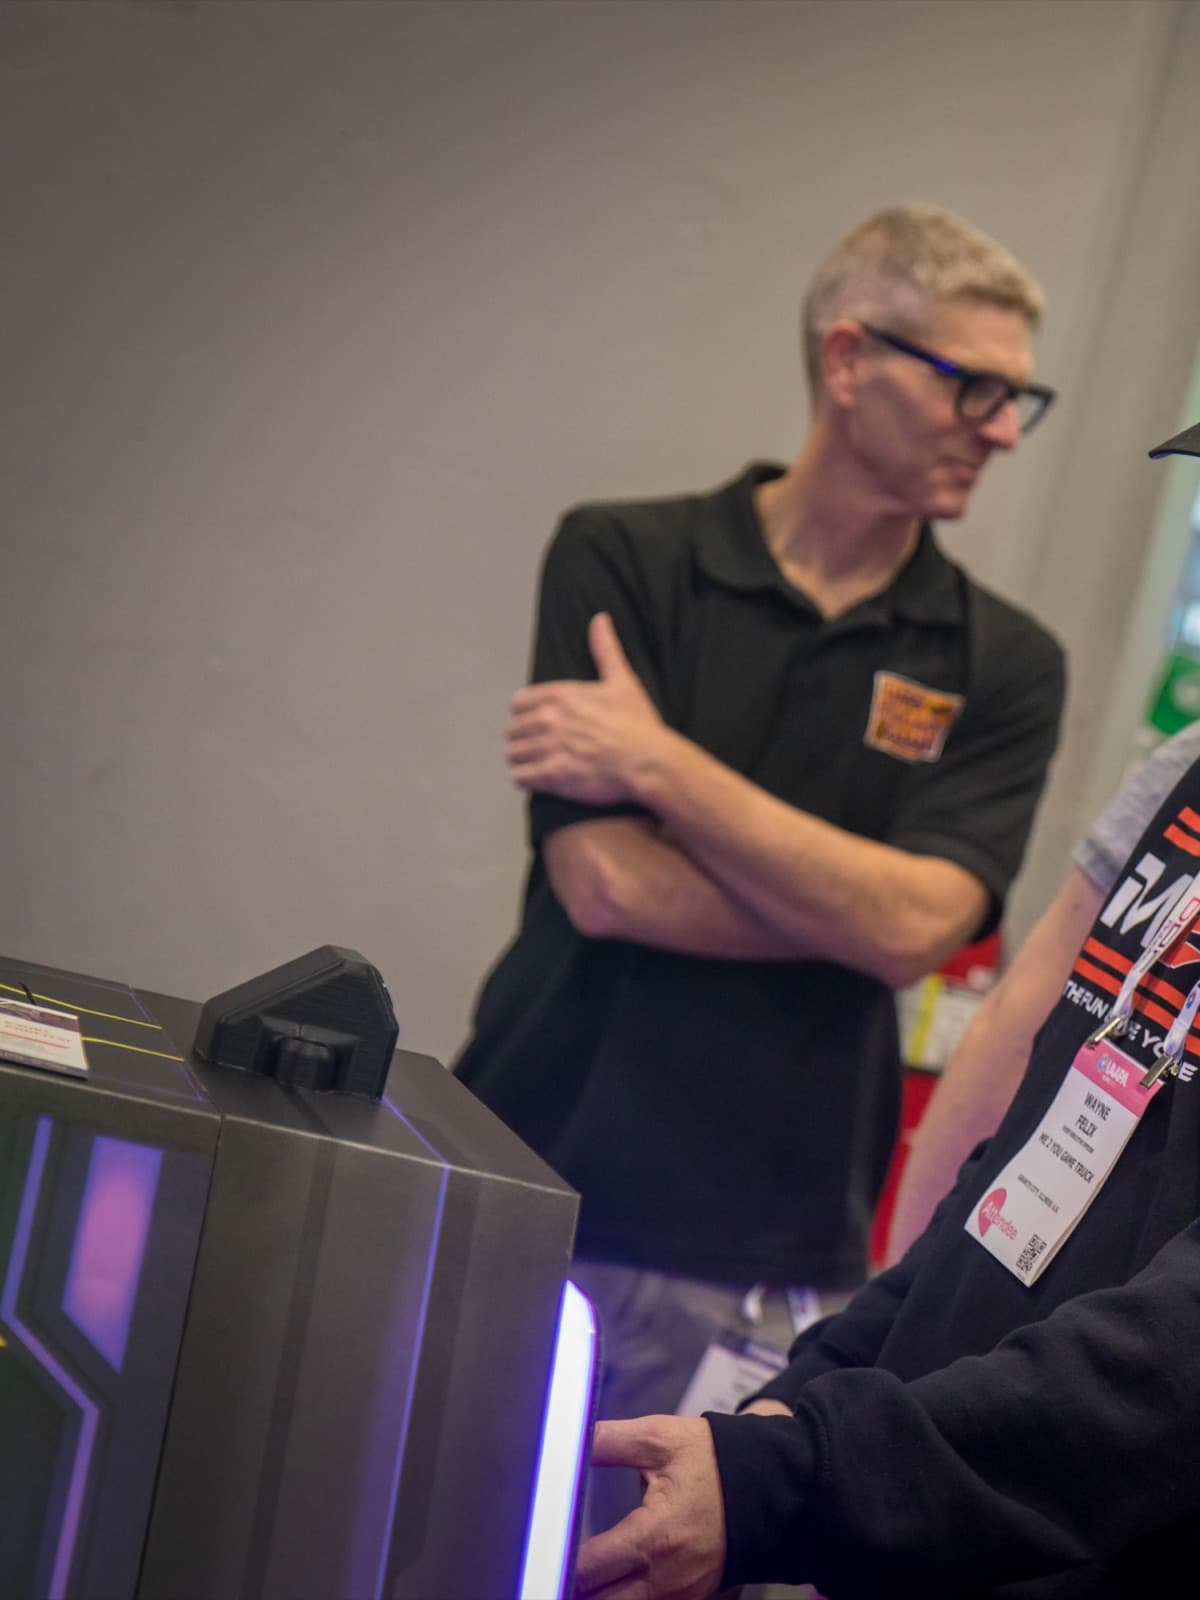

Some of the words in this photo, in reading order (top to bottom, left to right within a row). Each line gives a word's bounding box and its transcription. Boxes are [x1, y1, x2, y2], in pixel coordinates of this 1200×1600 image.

[1063, 980, 1085, 1005] THE
[1080, 990, 1110, 1019] FUN
[1105, 1059, 1129, 1088] IAAPA
[1084, 1091, 1111, 1121] WAYNE
[1075, 1114, 1099, 1138] FELIX
[1051, 1142, 1064, 1158] YOU
[1060, 1151, 1078, 1169] GAME
[1073, 1161, 1095, 1184] TRUCK
[981, 1200, 1019, 1241] Attendee
